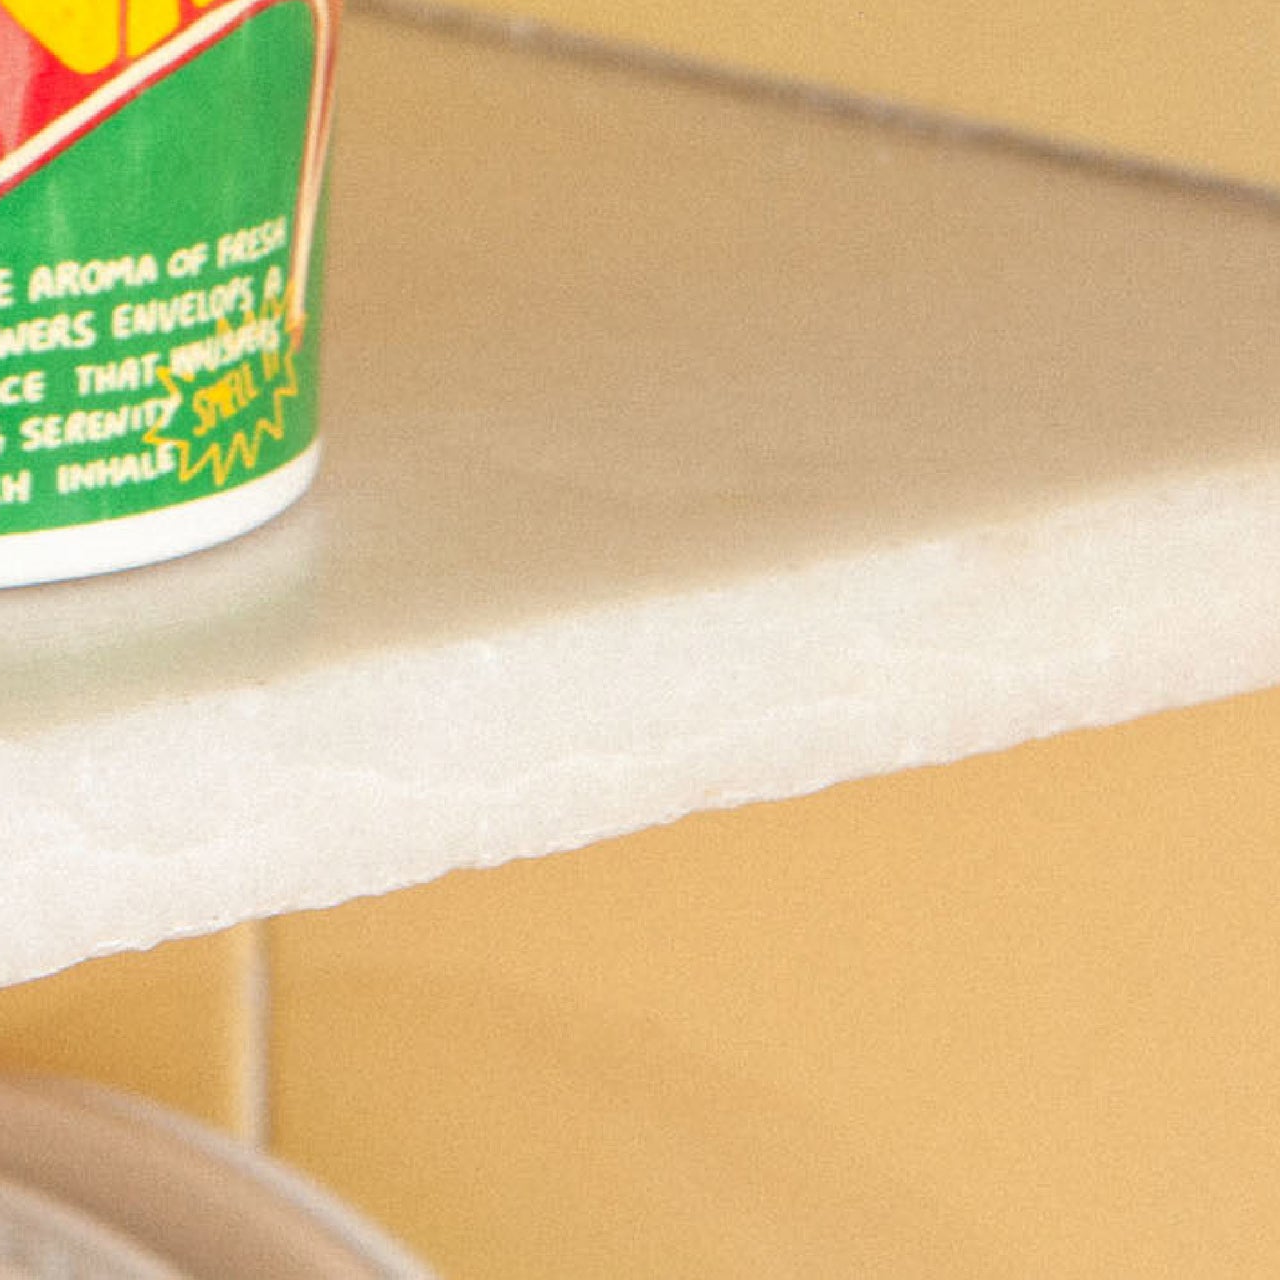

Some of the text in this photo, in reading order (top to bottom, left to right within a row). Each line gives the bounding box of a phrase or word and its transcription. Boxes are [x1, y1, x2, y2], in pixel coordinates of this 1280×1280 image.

[28, 254, 158, 303] AROMA
[167, 242, 210, 278] OF
[216, 216, 288, 270] FRESH
[111, 274, 255, 339] ENVELOPS
[75, 352, 161, 396] THAT
[18, 394, 182, 452] SERENITY
[56, 444, 178, 494] INHALE
